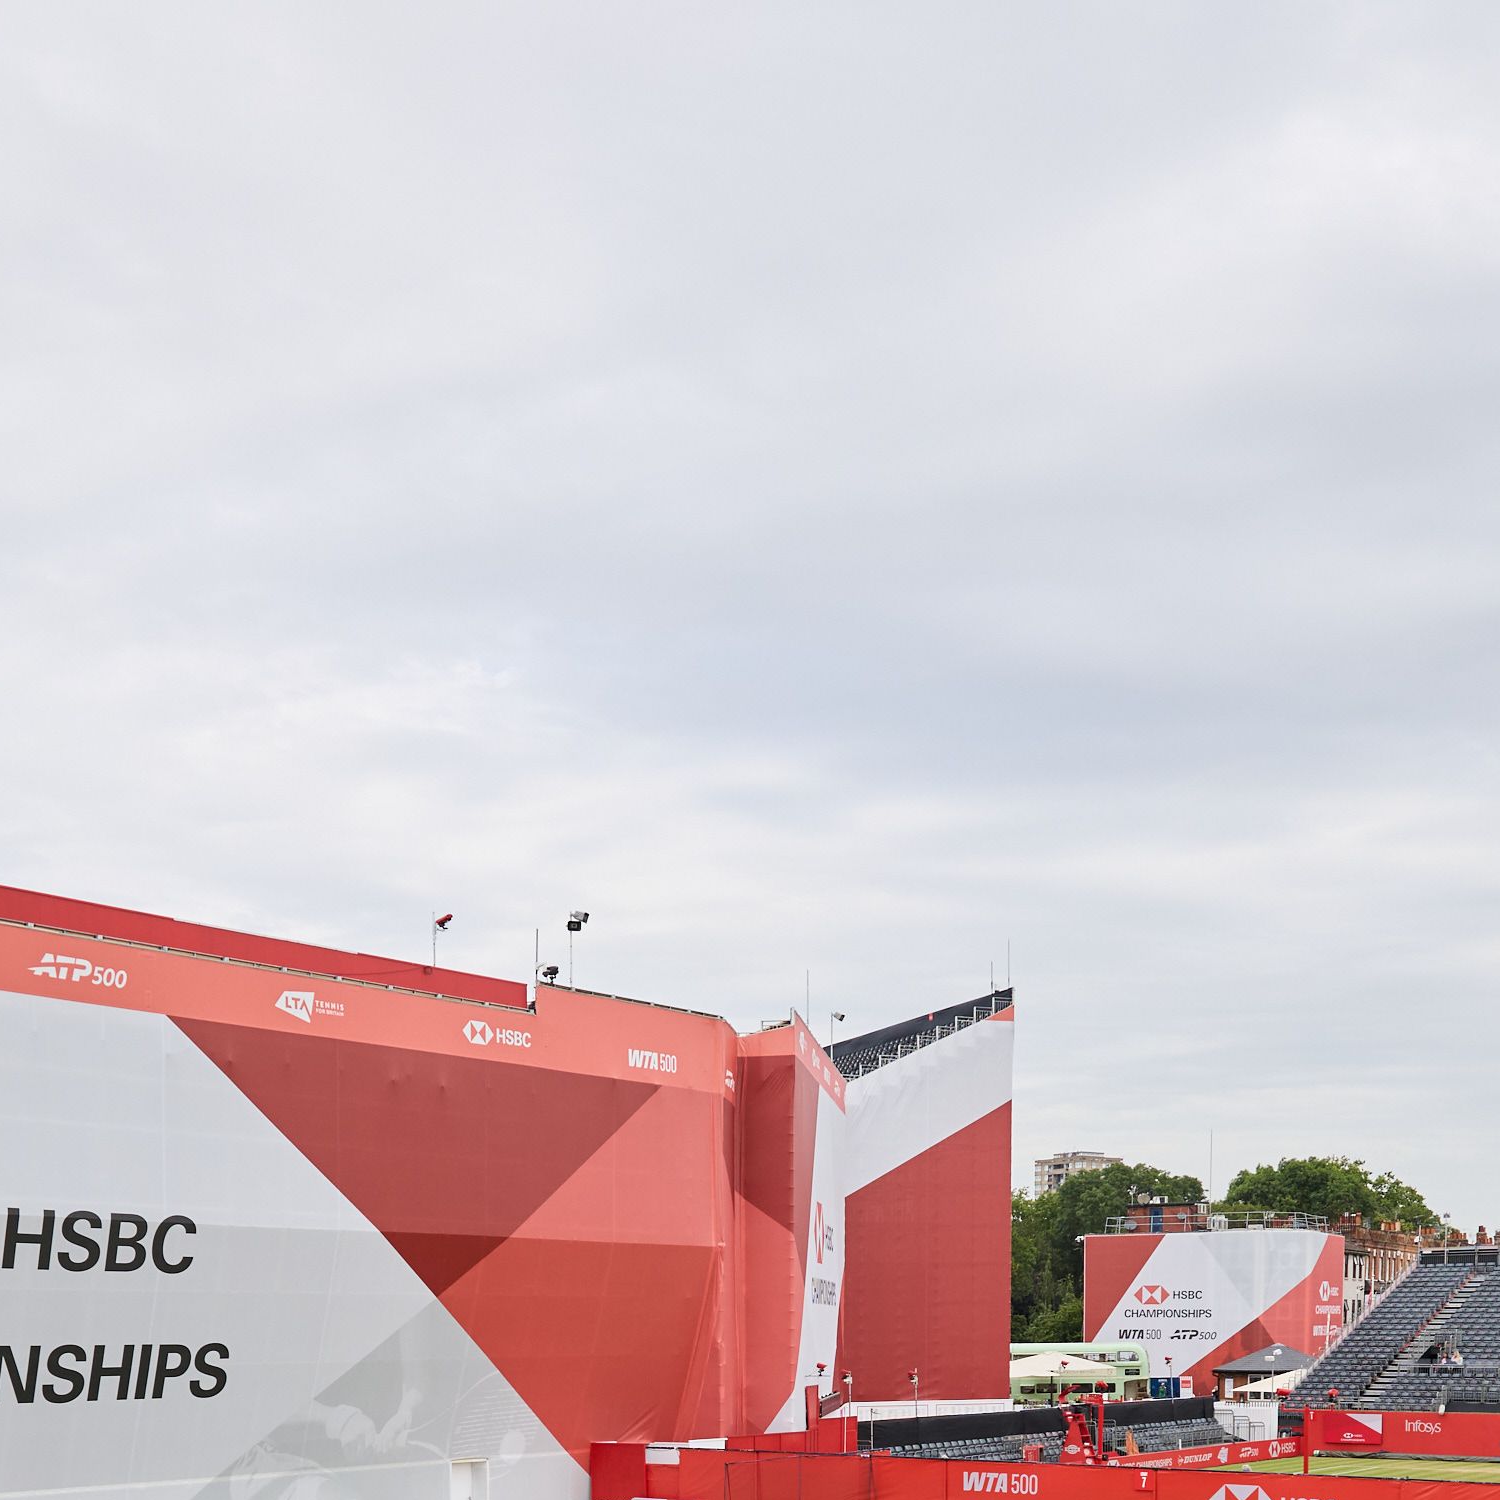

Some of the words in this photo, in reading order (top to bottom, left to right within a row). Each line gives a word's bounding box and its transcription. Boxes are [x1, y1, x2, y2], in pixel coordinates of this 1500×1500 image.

[27, 952, 93, 983] ATP
[92, 966, 128, 990] 500
[284, 994, 311, 1017] LTA
[315, 999, 345, 1012] TENNIS
[496, 1027, 532, 1049] HSBC
[628, 1048, 660, 1071] WTA
[659, 1053, 678, 1074] 500
[1, 1207, 198, 1275] HSBC
[1172, 1290, 1203, 1301] HSBC
[1124, 1308, 1212, 1319] CHAMPIONSHIPS
[1118, 1329, 1145, 1340] WTA
[1146, 1329, 1162, 1340] 500
[1170, 1329, 1199, 1340] ATP
[1198, 1331, 1218, 1341] 500
[1404, 1419, 1442, 1435] Infosys
[1280, 1441, 1296, 1454] HSBC
[1184, 1453, 1213, 1464] DUNLOP
[962, 1471, 1008, 1493] WTA
[1011, 1474, 1038, 1495] 500
[1141, 1476, 1147, 1489] 7
